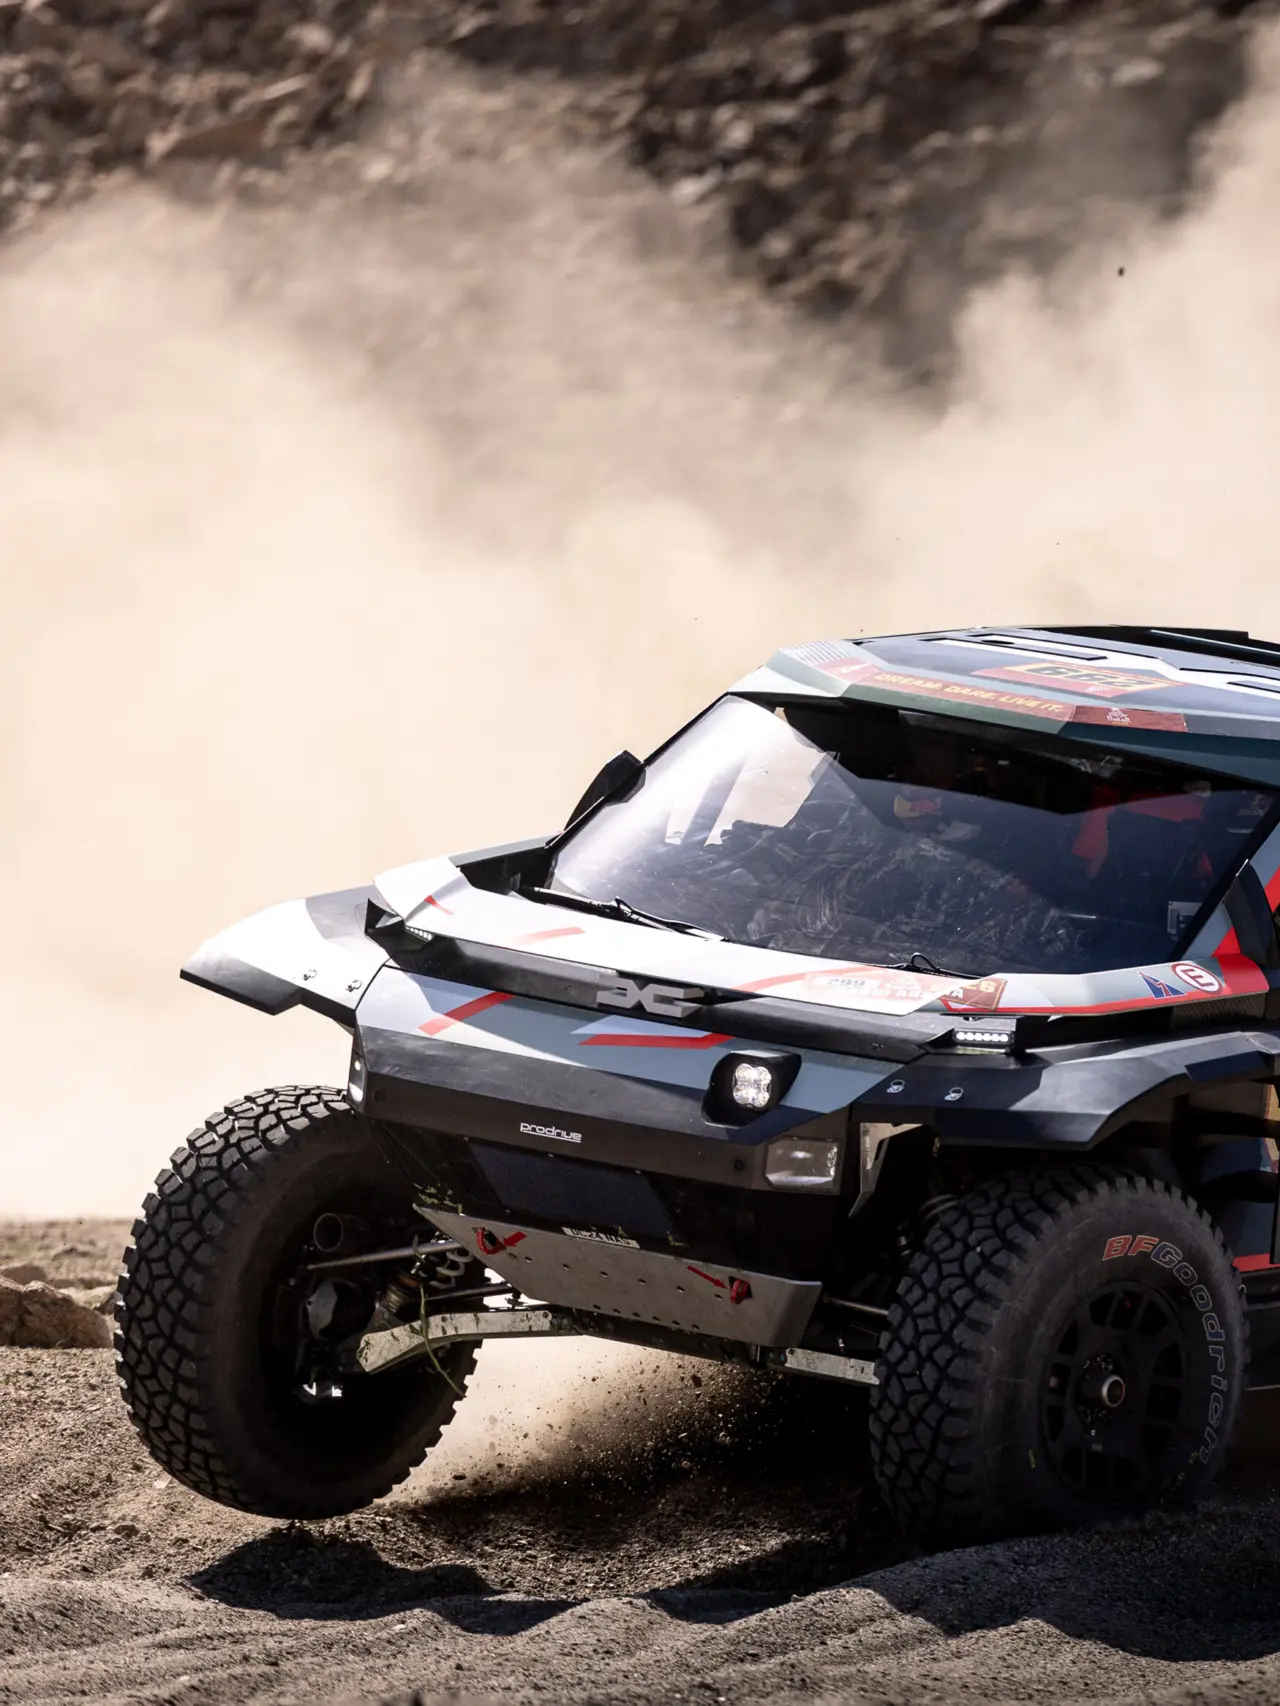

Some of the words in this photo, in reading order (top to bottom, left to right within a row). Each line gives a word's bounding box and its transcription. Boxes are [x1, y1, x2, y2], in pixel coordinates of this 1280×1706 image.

[874, 673, 941, 689] DREAM.
[942, 684, 996, 701] DARE.
[998, 696, 1038, 709] LIVE
[520, 1122, 582, 1141] prodrive
[1102, 1235, 1227, 1464] BFGoodrich
